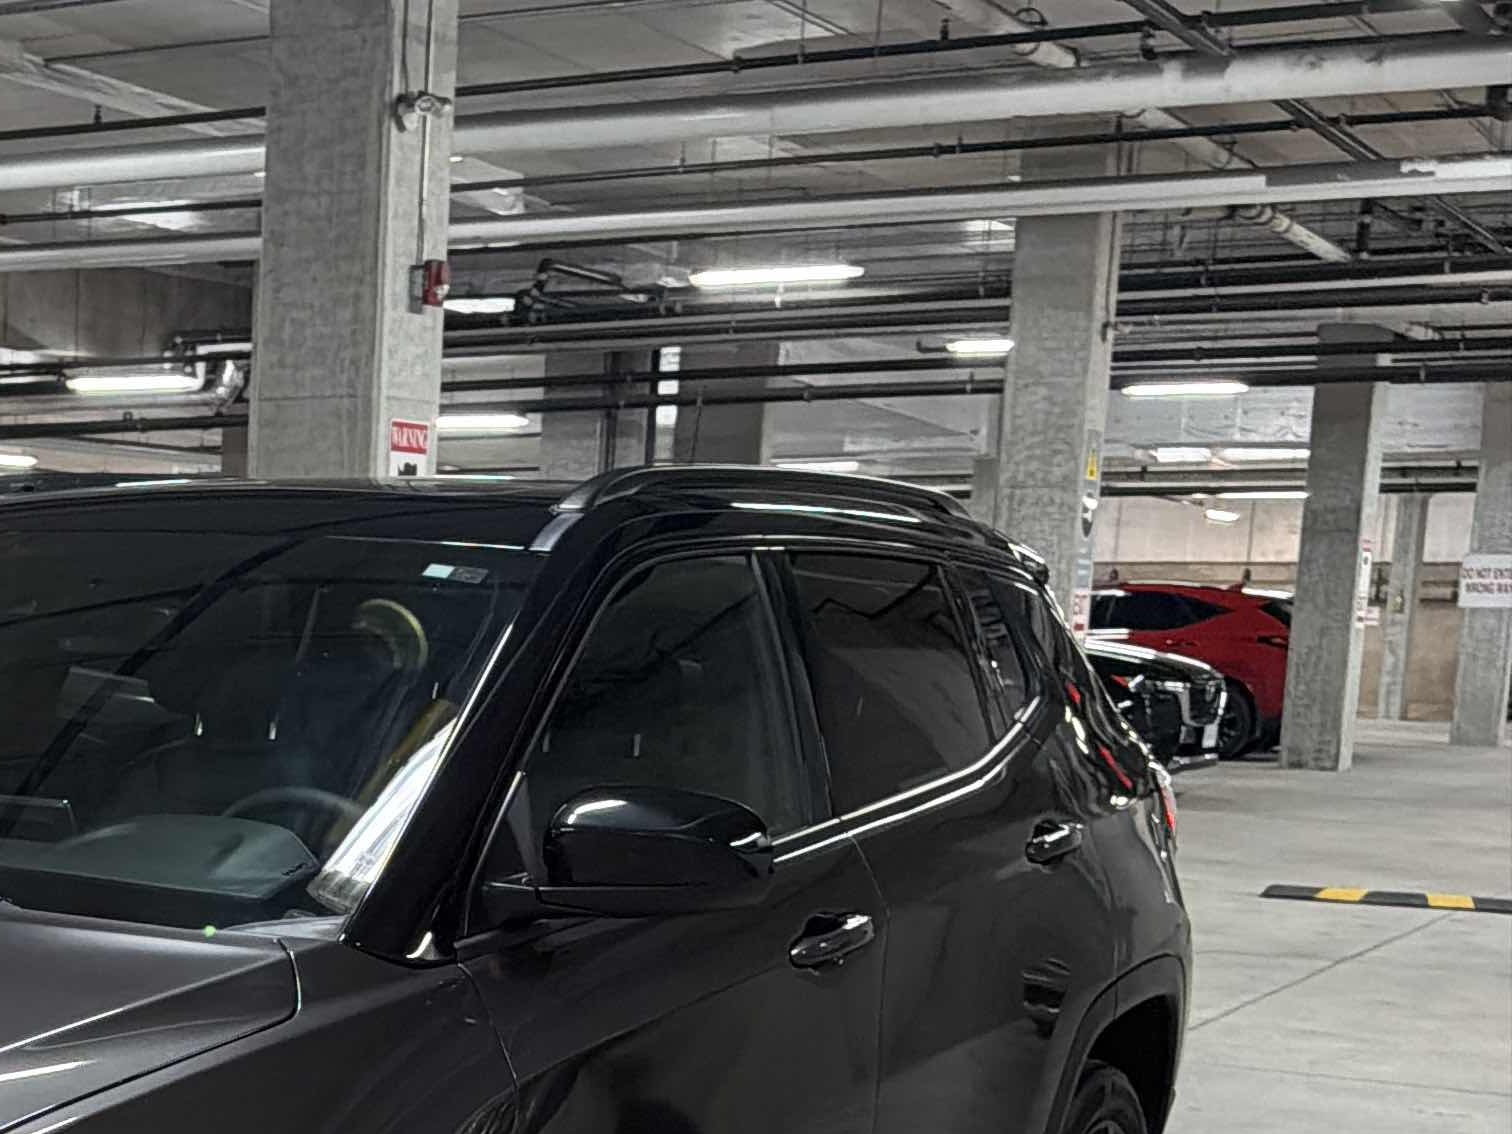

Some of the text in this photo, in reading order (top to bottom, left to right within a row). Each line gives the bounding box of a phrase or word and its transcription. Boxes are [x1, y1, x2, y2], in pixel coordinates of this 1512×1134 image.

[1462, 567, 1474, 579] DO
[1476, 567, 1492, 579] NOT
[1465, 581, 1494, 594] WRONG
